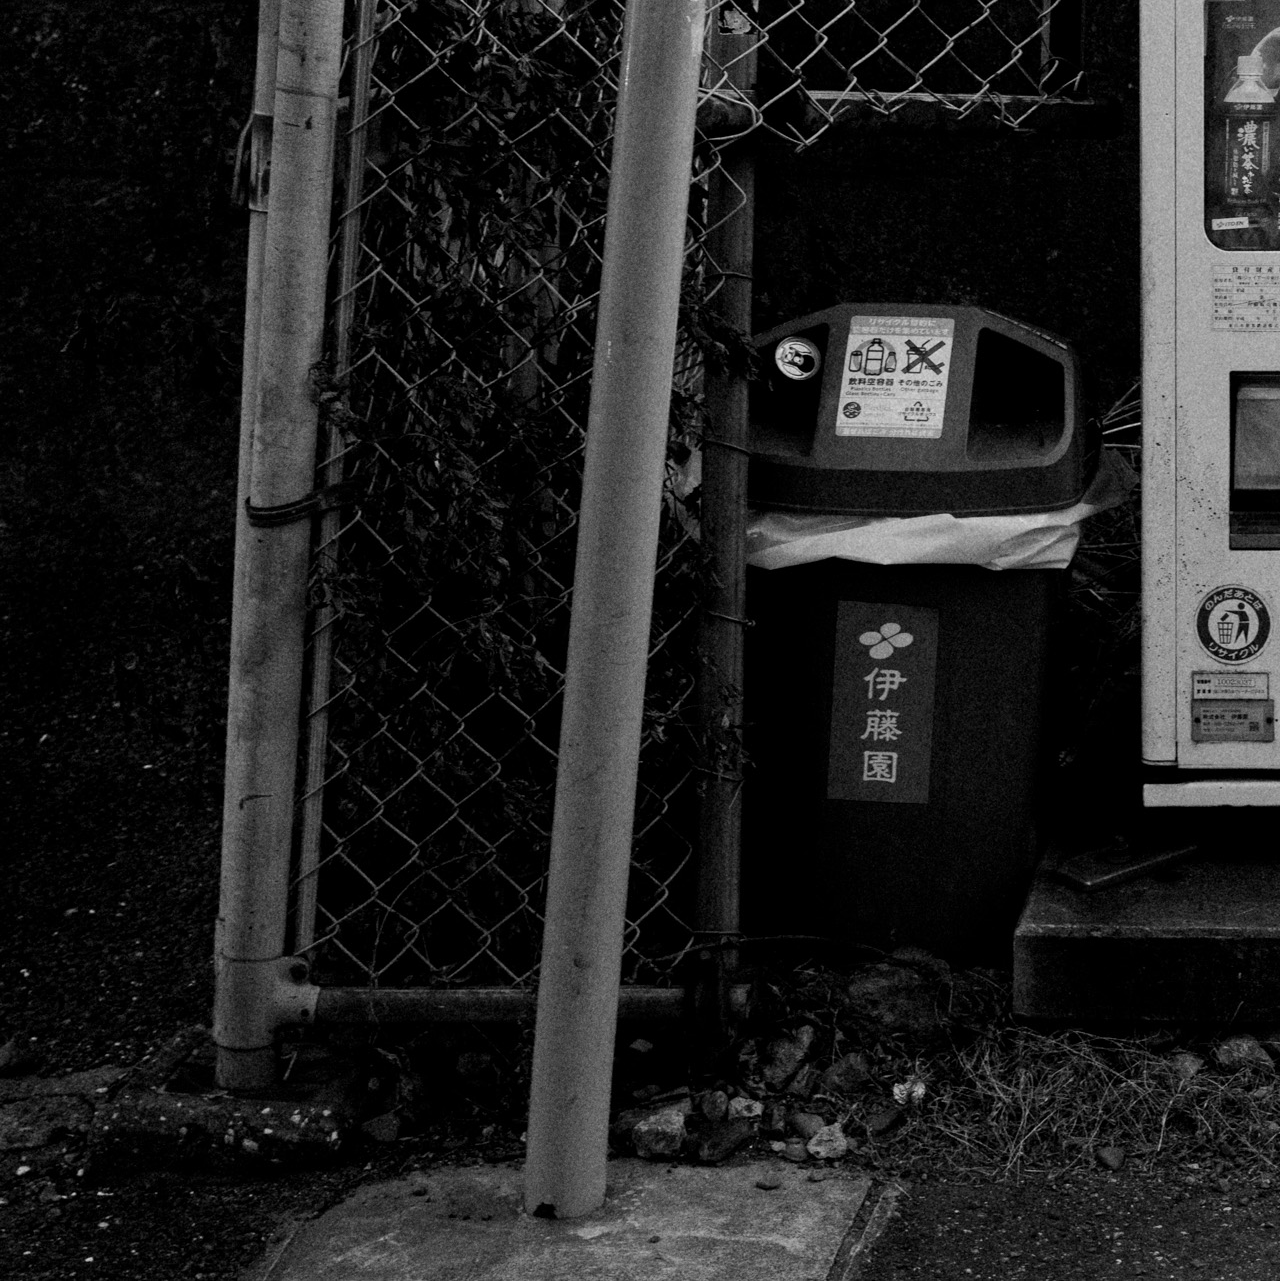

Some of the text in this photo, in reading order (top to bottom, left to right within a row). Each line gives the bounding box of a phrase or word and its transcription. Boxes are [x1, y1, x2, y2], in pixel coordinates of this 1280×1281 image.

[1237, 120, 1260, 170] 濃い茶
[1204, 588, 1263, 611] のんだあとは
[1208, 642, 1260, 661] リサイクル
[860, 666, 908, 784] 伊藤園
